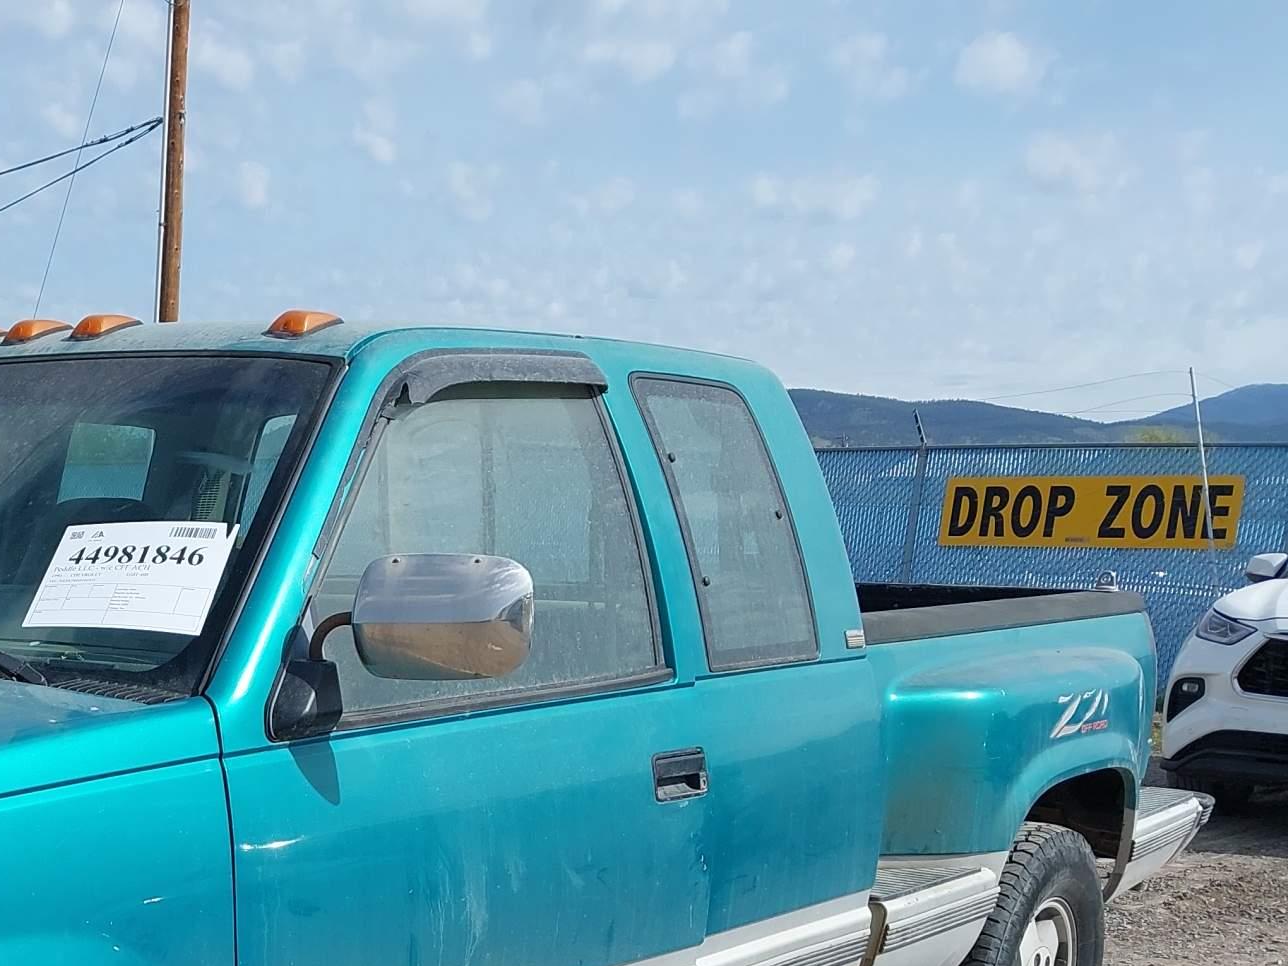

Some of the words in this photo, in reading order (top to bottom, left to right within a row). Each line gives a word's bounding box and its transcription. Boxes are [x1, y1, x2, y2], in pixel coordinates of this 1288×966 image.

[948, 485, 1075, 538] DROP
[1097, 484, 1234, 539] ZONE
[68, 544, 208, 566] 44981846
